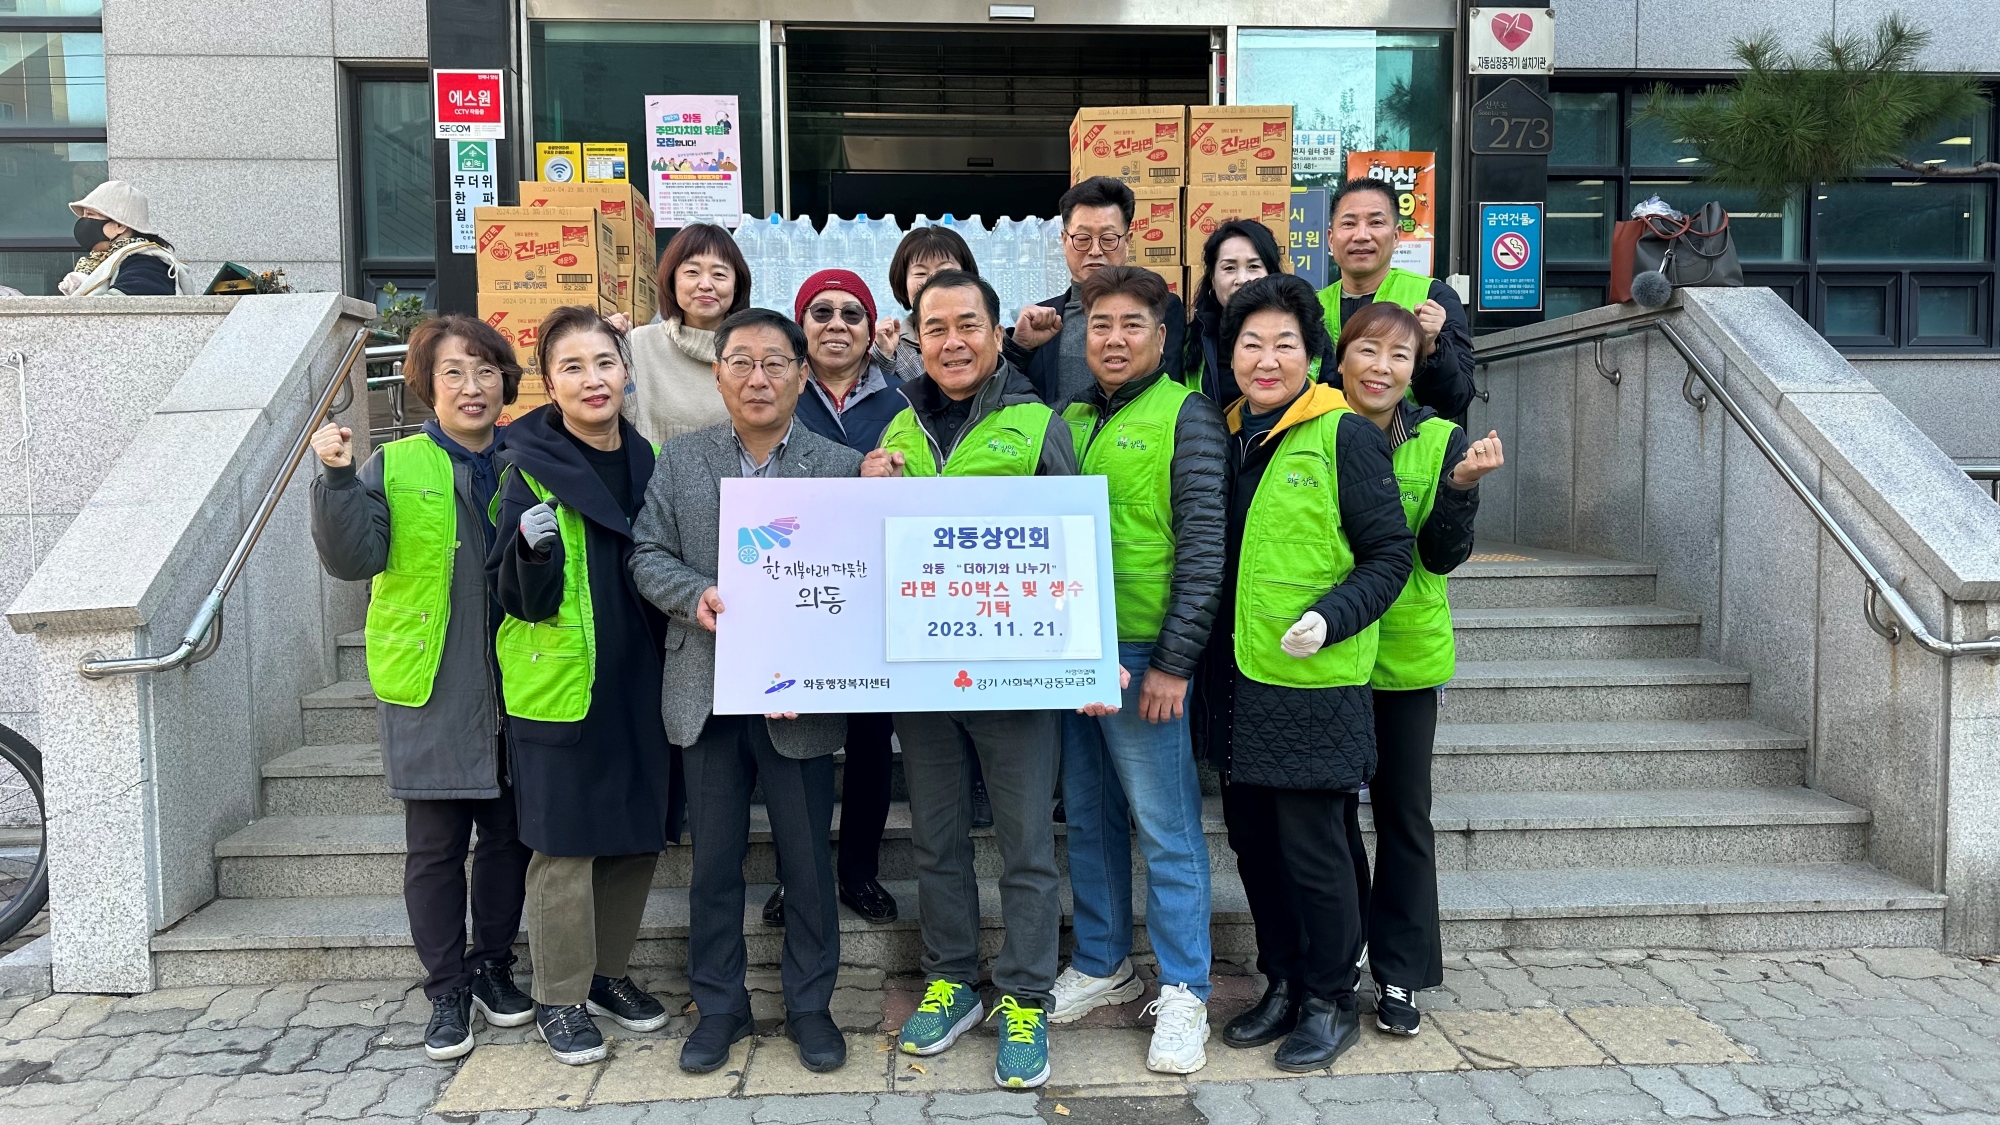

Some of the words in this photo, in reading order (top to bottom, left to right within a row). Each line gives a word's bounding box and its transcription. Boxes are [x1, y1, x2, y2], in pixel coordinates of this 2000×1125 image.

[1477, 56, 1520, 70] 자동심장충격기
[1521, 56, 1547, 70] 설치기관
[448, 90, 491, 107] 에스원
[682, 113, 702, 123] 와동
[439, 124, 471, 133] SECOM
[656, 125, 702, 136] 주민자치회
[704, 125, 730, 136] 위원을
[1488, 117, 1551, 149] 273
[656, 137, 697, 148] 모집합니다!
[1220, 136, 1261, 156] 진라면
[1316, 133, 1336, 146] 쉼터
[1113, 137, 1154, 158] 진라면
[1307, 147, 1321, 156] 쉼터
[1322, 147, 1336, 156] 겸용
[454, 174, 493, 189] 무더위
[1487, 212, 1531, 226] 금연건물
[514, 240, 561, 262] 진라면
[557, 255, 575, 265] 매운맛
[1289, 254, 1311, 271] 기
[1301, 475, 1319, 488] 상인회
[933, 526, 1050, 550] 와동상인회
[762, 555, 781, 580] 한
[783, 560, 830, 580] 지붕아래
[831, 559, 868, 579] 따뜻한
[922, 563, 946, 575] 와동
[901, 580, 937, 598] 라면
[947, 580, 1010, 598] 50박스
[1021, 580, 1038, 598] 및
[1048, 580, 1085, 598] 생수
[795, 586, 847, 615] 와동
[975, 600, 1012, 618] 기탁
[927, 621, 984, 637] 2023.
[993, 621, 1023, 637] 11.
[1033, 621, 1064, 637] 21.
[803, 677, 890, 690] 와동행정복지센터
[976, 677, 998, 691] 경기
[1000, 676, 1097, 690] 사회복지공동모금회
